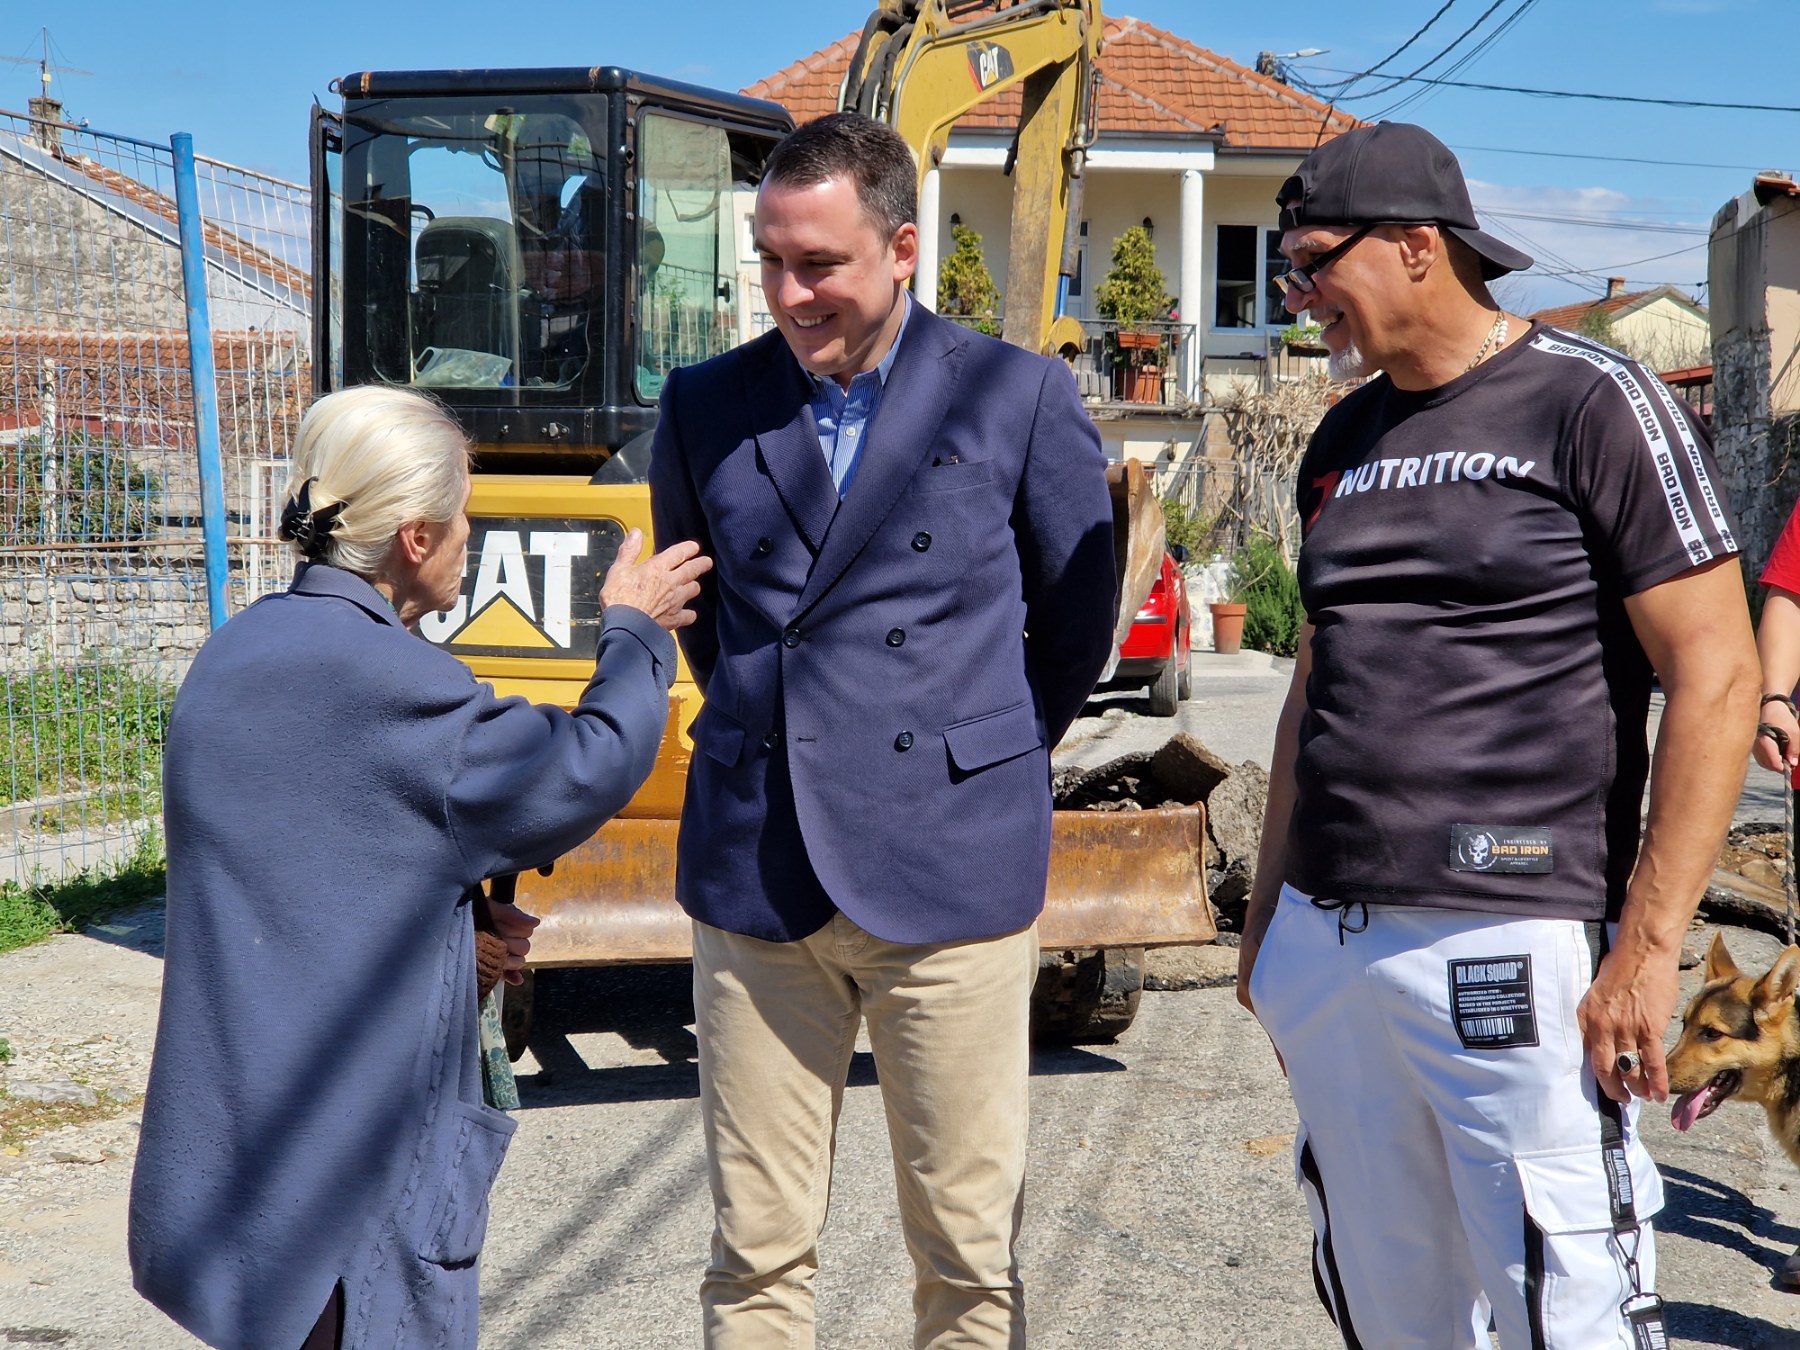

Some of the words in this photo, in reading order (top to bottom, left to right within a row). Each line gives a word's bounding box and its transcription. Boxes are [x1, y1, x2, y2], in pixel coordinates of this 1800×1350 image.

[979, 46, 999, 87] CAT
[1547, 343, 1577, 355] BAD
[1615, 370, 1641, 405] BAD
[1635, 402, 1661, 442] IRON
[1335, 451, 1536, 498] NUTRITION
[1656, 451, 1677, 490] BAD
[1669, 491, 1693, 531] IRON
[1491, 845, 1518, 855] BAD
[1520, 846, 1549, 855] IRON
[1456, 965, 1486, 984] BLACK
[1612, 1149, 1630, 1176] BLACK
